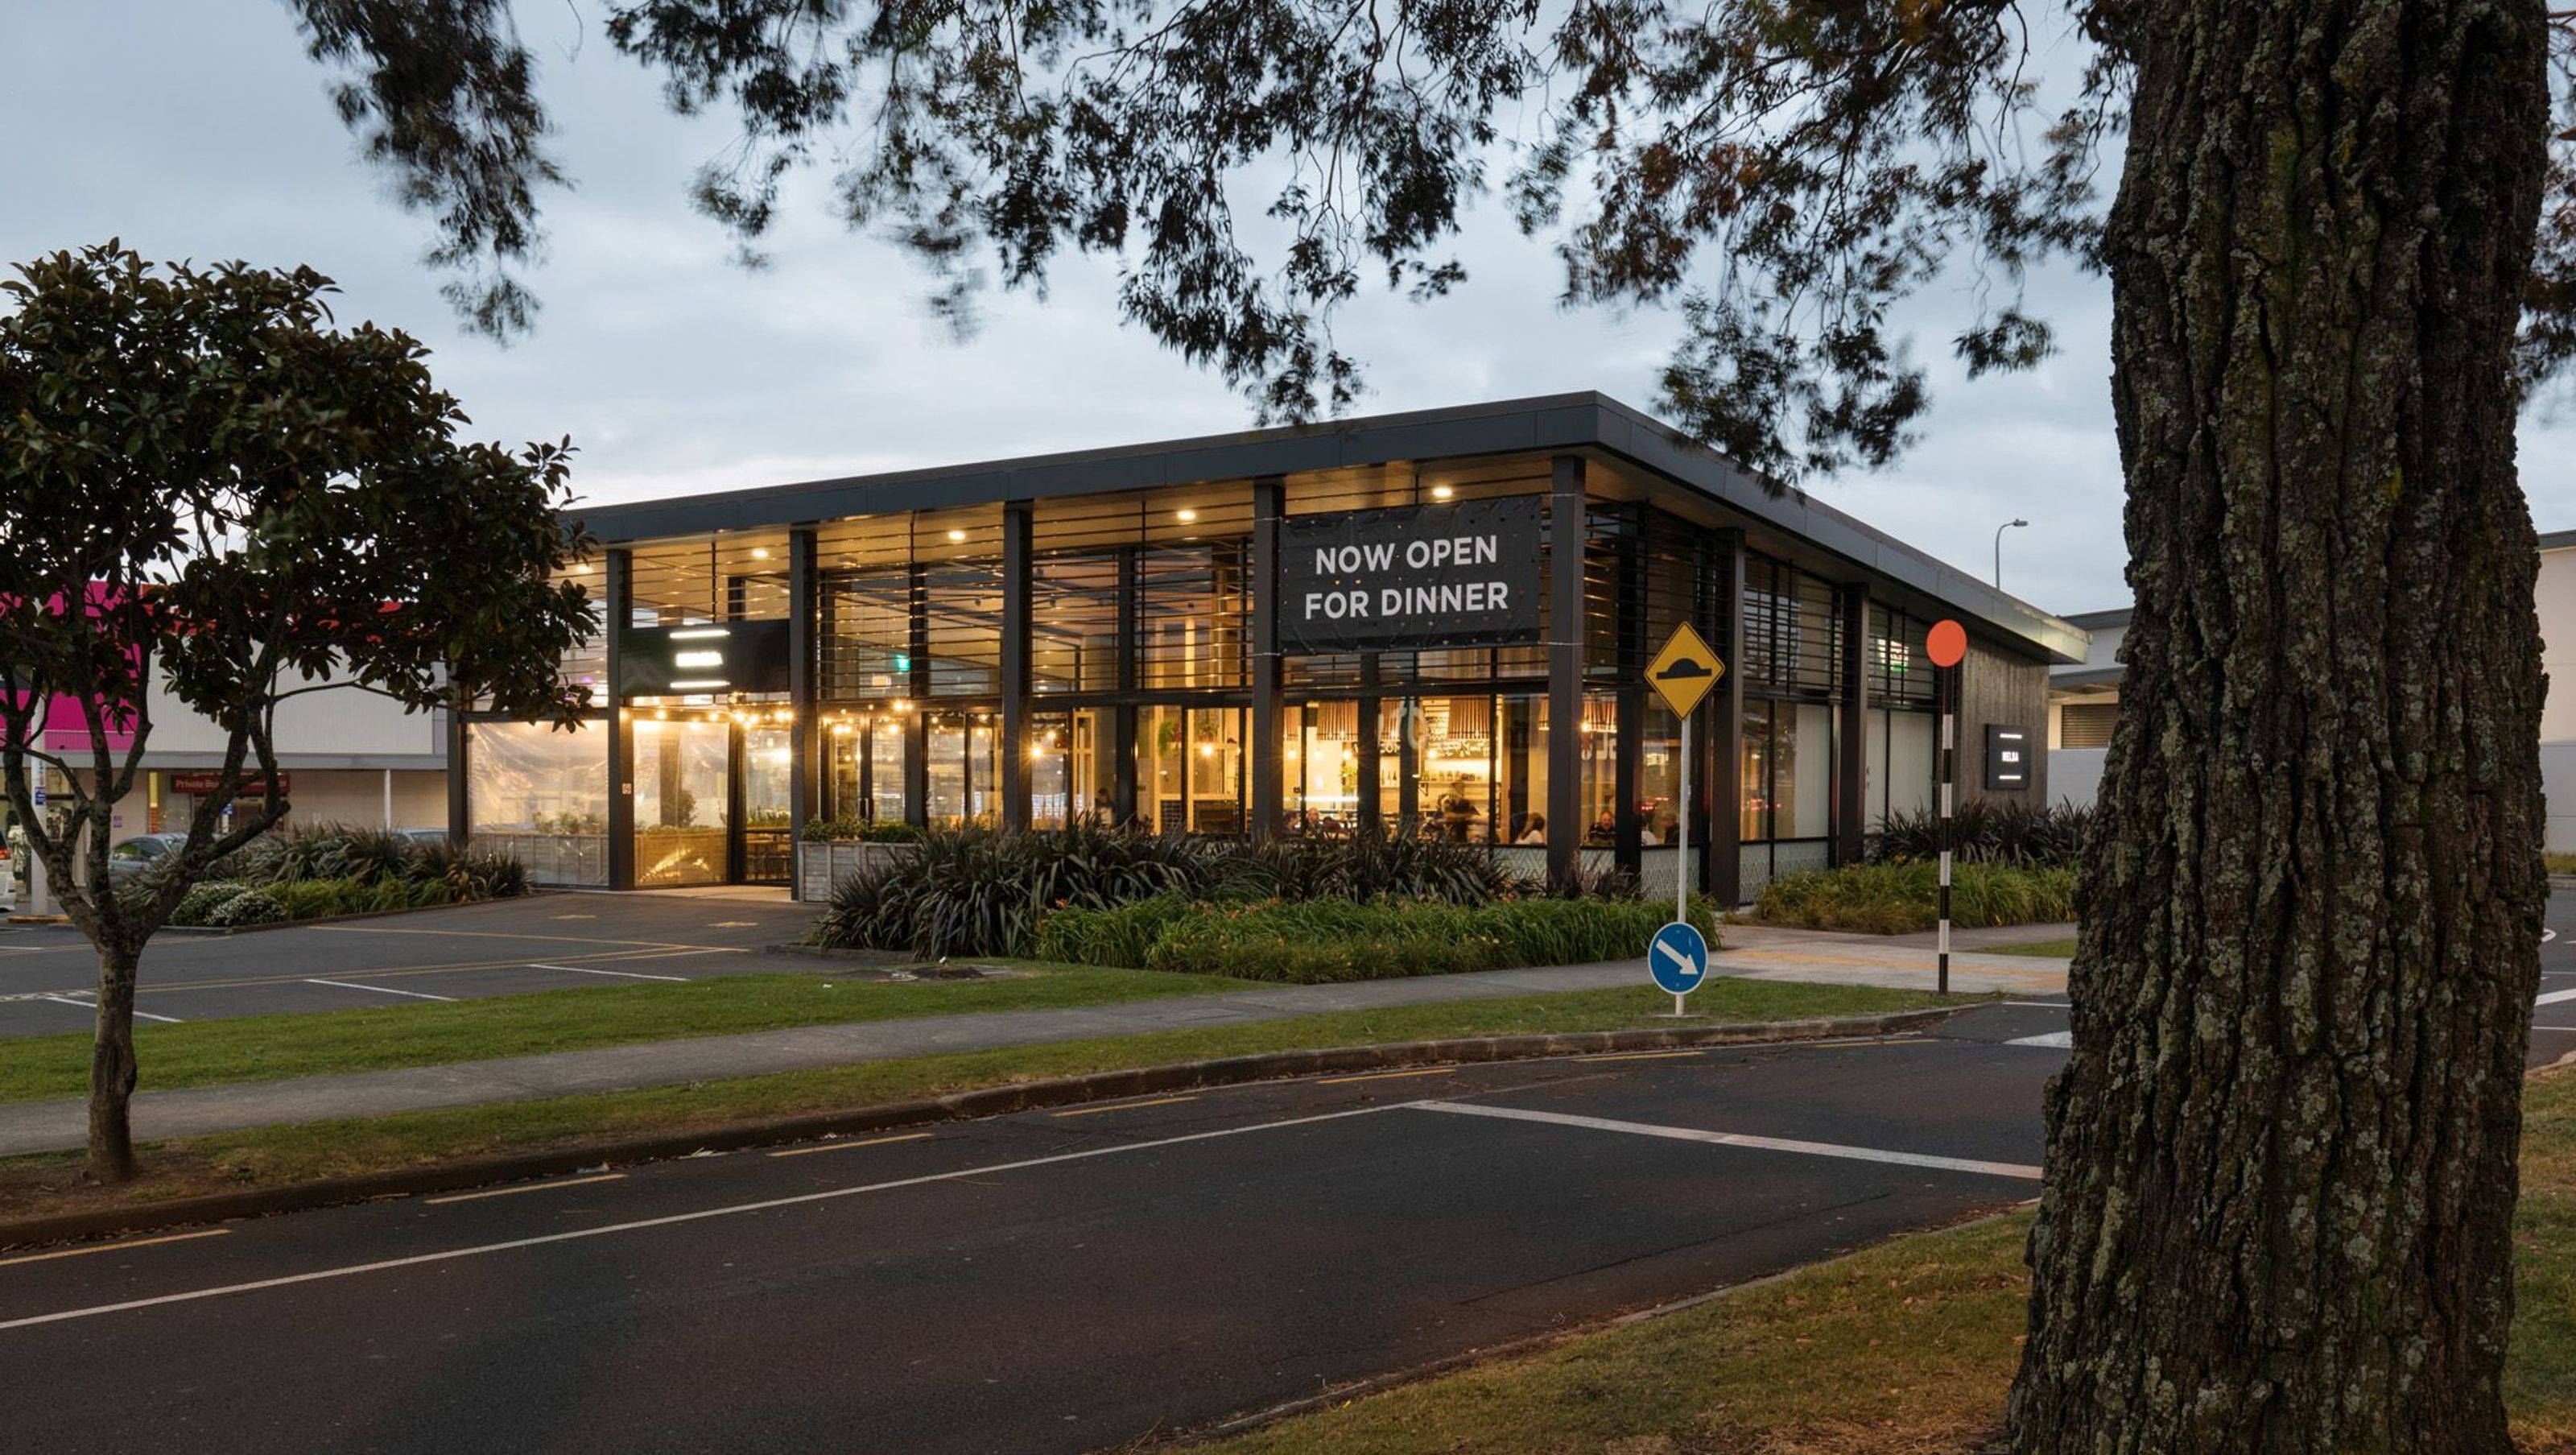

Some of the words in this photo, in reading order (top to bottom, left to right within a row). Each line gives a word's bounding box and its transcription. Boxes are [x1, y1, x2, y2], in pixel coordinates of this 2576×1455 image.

[1316, 543, 1395, 575] NOW
[1406, 535, 1497, 569] OPEN
[1305, 590, 1369, 620] FOR
[1381, 581, 1509, 616] DINNER
